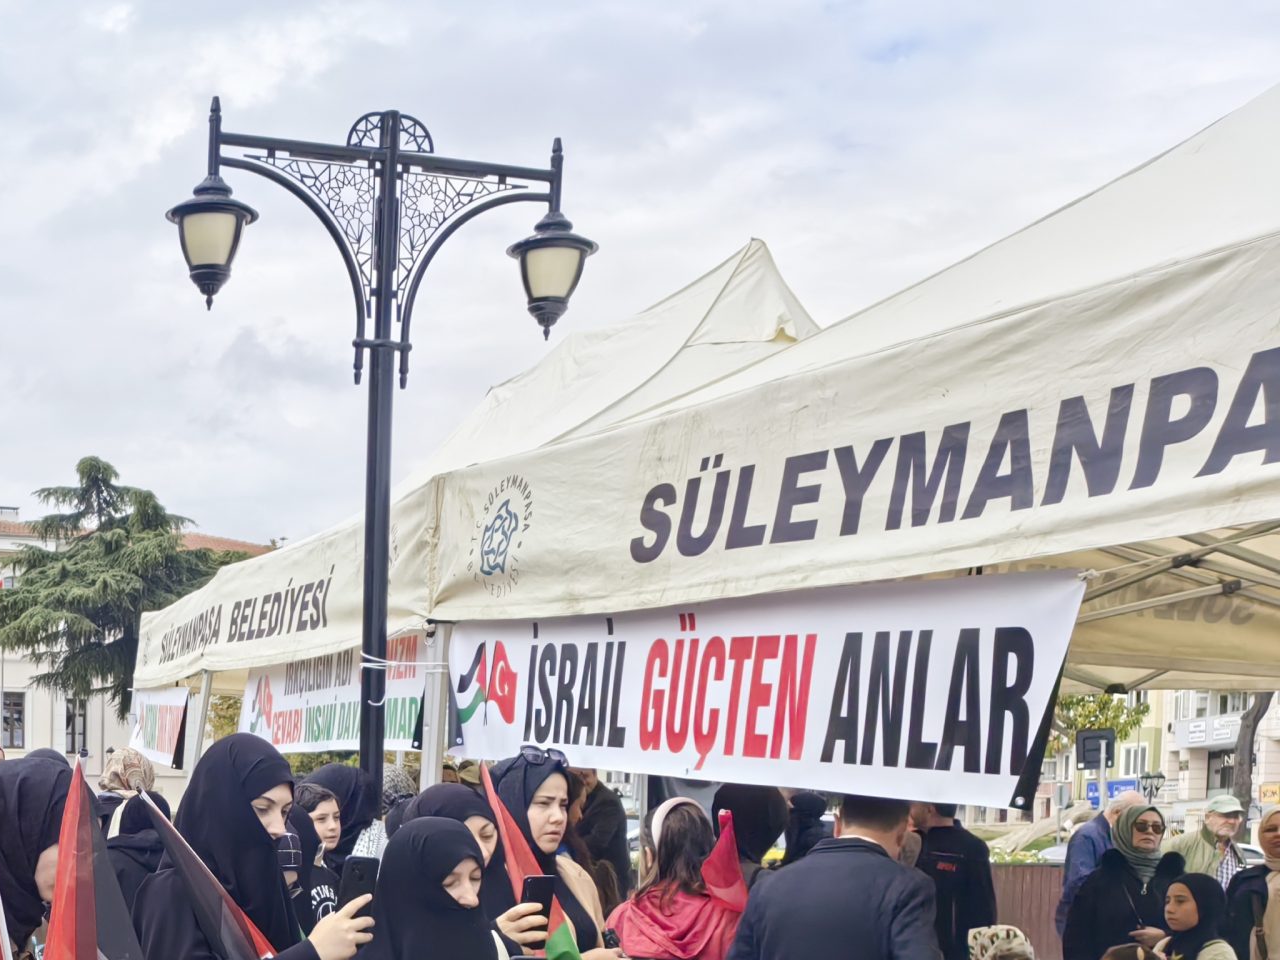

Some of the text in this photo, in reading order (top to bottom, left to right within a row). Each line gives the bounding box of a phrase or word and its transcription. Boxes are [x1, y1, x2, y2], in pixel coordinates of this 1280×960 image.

[227, 564, 335, 643] BELEDİYESİ
[272, 708, 303, 745] CEVABI
[522, 613, 1035, 776] İSRAİL GÜÇTEN ANLAR
